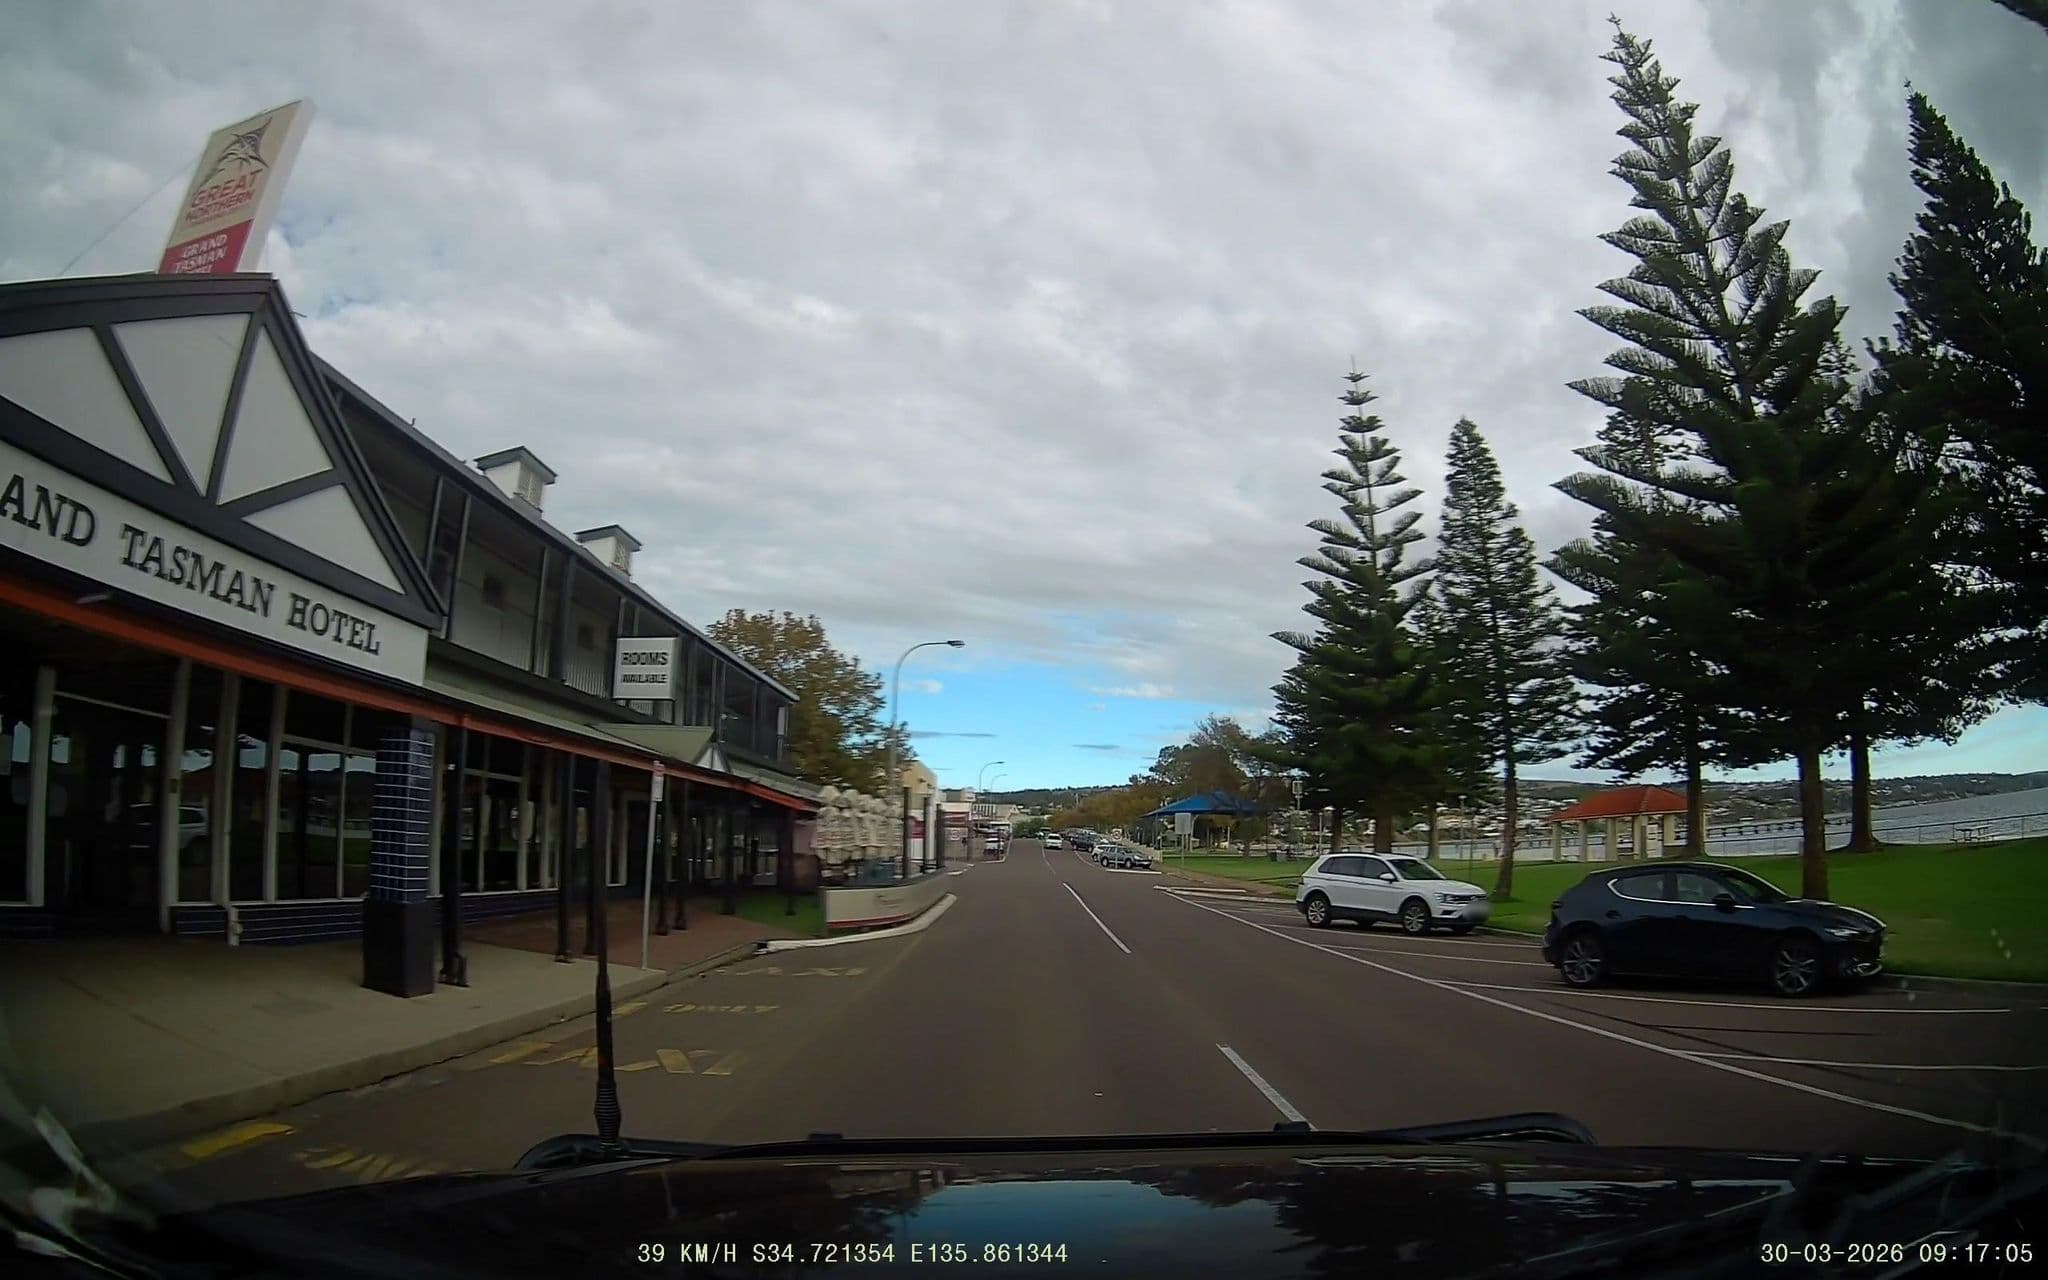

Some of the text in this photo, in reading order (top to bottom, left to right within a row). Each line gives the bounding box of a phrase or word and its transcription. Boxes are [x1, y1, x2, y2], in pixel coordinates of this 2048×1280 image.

[192, 168, 263, 207] GREAT
[175, 246, 228, 273] TASMAN
[182, 234, 227, 259] GRAND
[121, 523, 276, 617] TASMAN
[287, 593, 380, 656] HOTEL
[621, 651, 668, 666] ROOMS
[622, 674, 667, 684] AVAILABLE
